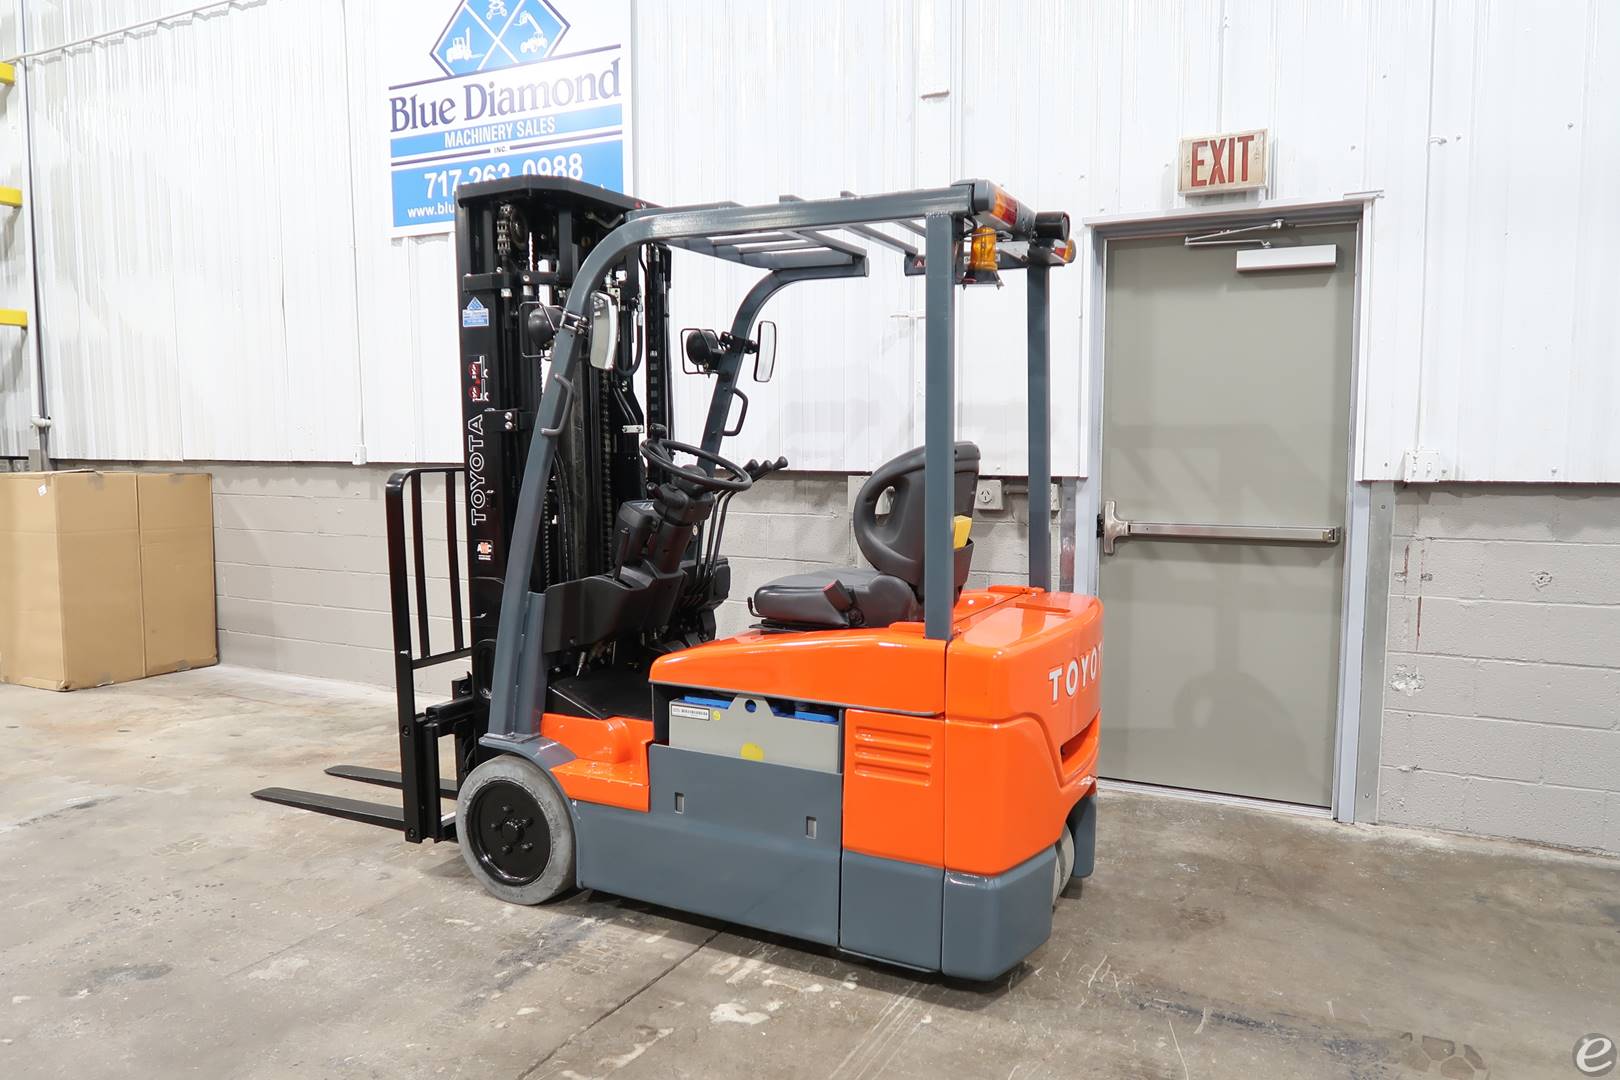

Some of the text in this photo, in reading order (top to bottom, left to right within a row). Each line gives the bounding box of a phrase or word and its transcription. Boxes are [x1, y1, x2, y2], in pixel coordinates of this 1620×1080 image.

[389, 58, 621, 132] Blue Diamond
[444, 116, 556, 148] MACHINERY SALES
[424, 153, 583, 198] 717-2630988
[1191, 135, 1254, 187] EXIT
[407, 203, 456, 218] www.blu
[467, 414, 487, 526] TOYOTA
